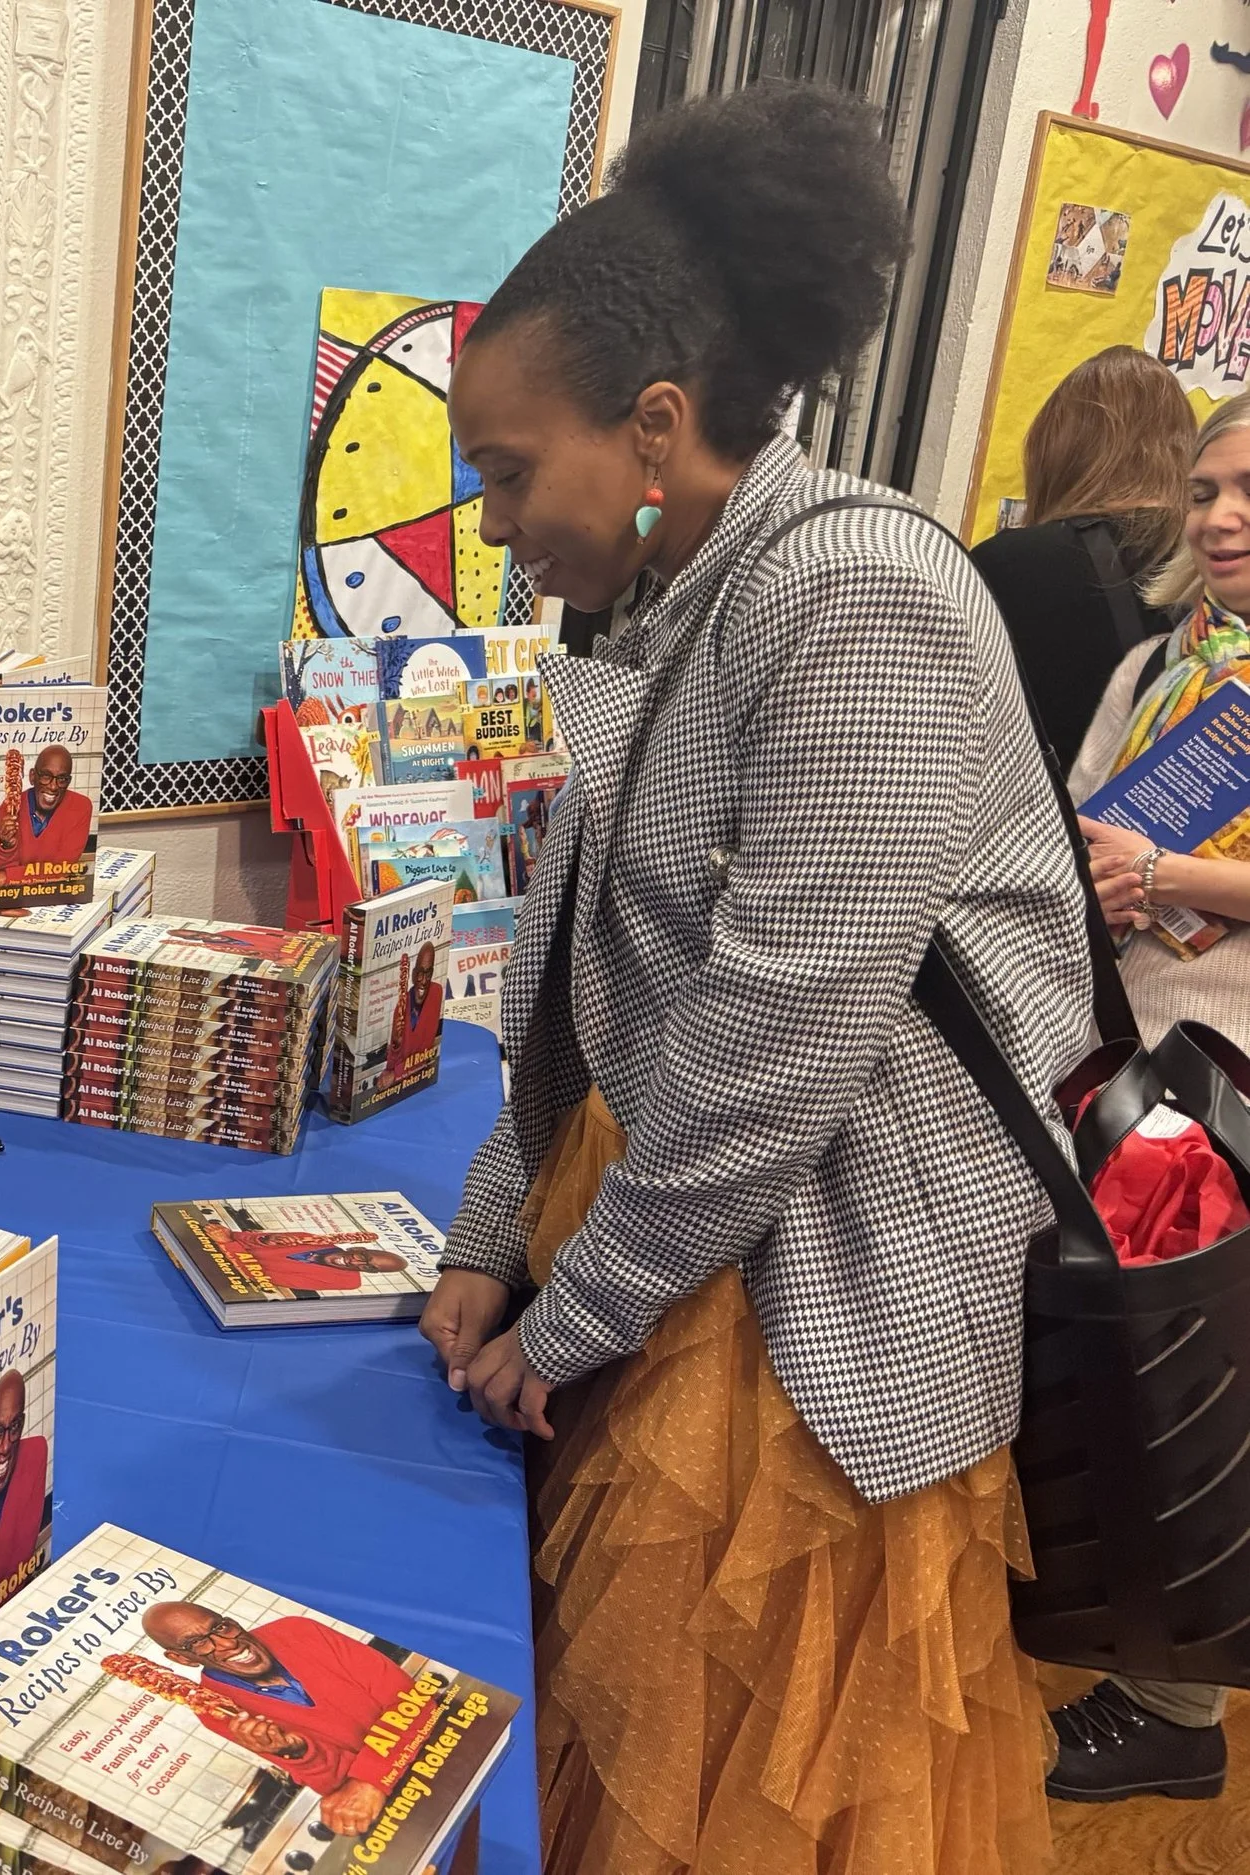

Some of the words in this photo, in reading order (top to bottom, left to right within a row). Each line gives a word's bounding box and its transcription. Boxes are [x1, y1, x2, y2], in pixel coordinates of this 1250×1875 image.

[340, 656, 354, 668] the
[411, 668, 435, 682] Little
[436, 666, 460, 678] Witch
[312, 671, 344, 689] SNOW
[411, 685, 426, 696] Who
[429, 679, 449, 692] Lost
[481, 710, 512, 726] BEST
[1220, 712, 1241, 730] dishes
[1230, 704, 1244, 717] 100
[12, 729, 25, 739] to
[30, 726, 65, 743] Live
[68, 725, 89, 746] By
[1211, 718, 1232, 736] Roker
[308, 735, 361, 764] Leaves
[401, 742, 455, 757] SNOWMEN
[1202, 727, 1223, 745] recipe
[1223, 742, 1237, 756] box
[422, 758, 444, 766] NIGHT
[24, 863, 40, 876] Al
[44, 860, 85, 874] Roker
[405, 865, 430, 877] Diggers
[432, 865, 447, 873] Love
[22, 885, 57, 896] Roker
[60, 884, 85, 896] Laga
[374, 916, 389, 939] Al
[392, 901, 437, 933] Roker's
[372, 939, 403, 959] Recipes
[403, 934, 412, 946] to
[414, 926, 433, 944] Live
[433, 920, 445, 939] By
[457, 948, 510, 973] EDWAR
[93, 962, 104, 971] Al
[107, 964, 143, 976] Roker's
[145, 969, 172, 981] Recipes
[182, 976, 199, 984] Live
[201, 977, 212, 987] By
[377, 1201, 410, 1214] Al
[186, 1220, 218, 1252] Courtney
[211, 1252, 235, 1276] Roker
[228, 1276, 249, 1295] Laga
[236, 1252, 252, 1260] Al
[246, 1264, 277, 1293] Roker
[18, 1322, 41, 1358] By
[72, 1632, 102, 1656] to
[89, 1590, 147, 1636] Live
[133, 1566, 178, 1595] By
[380, 1671, 442, 1731] Roker
[59, 1728, 90, 1753] Easy,
[80, 1693, 156, 1763] Memory-Making
[380, 1769, 399, 1787] New
[396, 1752, 410, 1772] York
[404, 1729, 425, 1759] Times
[417, 1701, 449, 1738] bestselling
[443, 1684, 461, 1709] author
[101, 1743, 137, 1774] Family
[130, 1713, 164, 1745] Dishes
[363, 1724, 401, 1758] Al
[127, 1769, 143, 1787] for
[137, 1742, 170, 1770] Every
[147, 1751, 192, 1796] Occasion
[353, 1775, 432, 1864] Courtney
[411, 1726, 463, 1780] Roker
[447, 1692, 489, 1729] Laga
[14, 1781, 68, 1820] Recipes
[69, 1813, 85, 1830] to
[86, 1823, 124, 1850] Live
[126, 1841, 149, 1866] By
